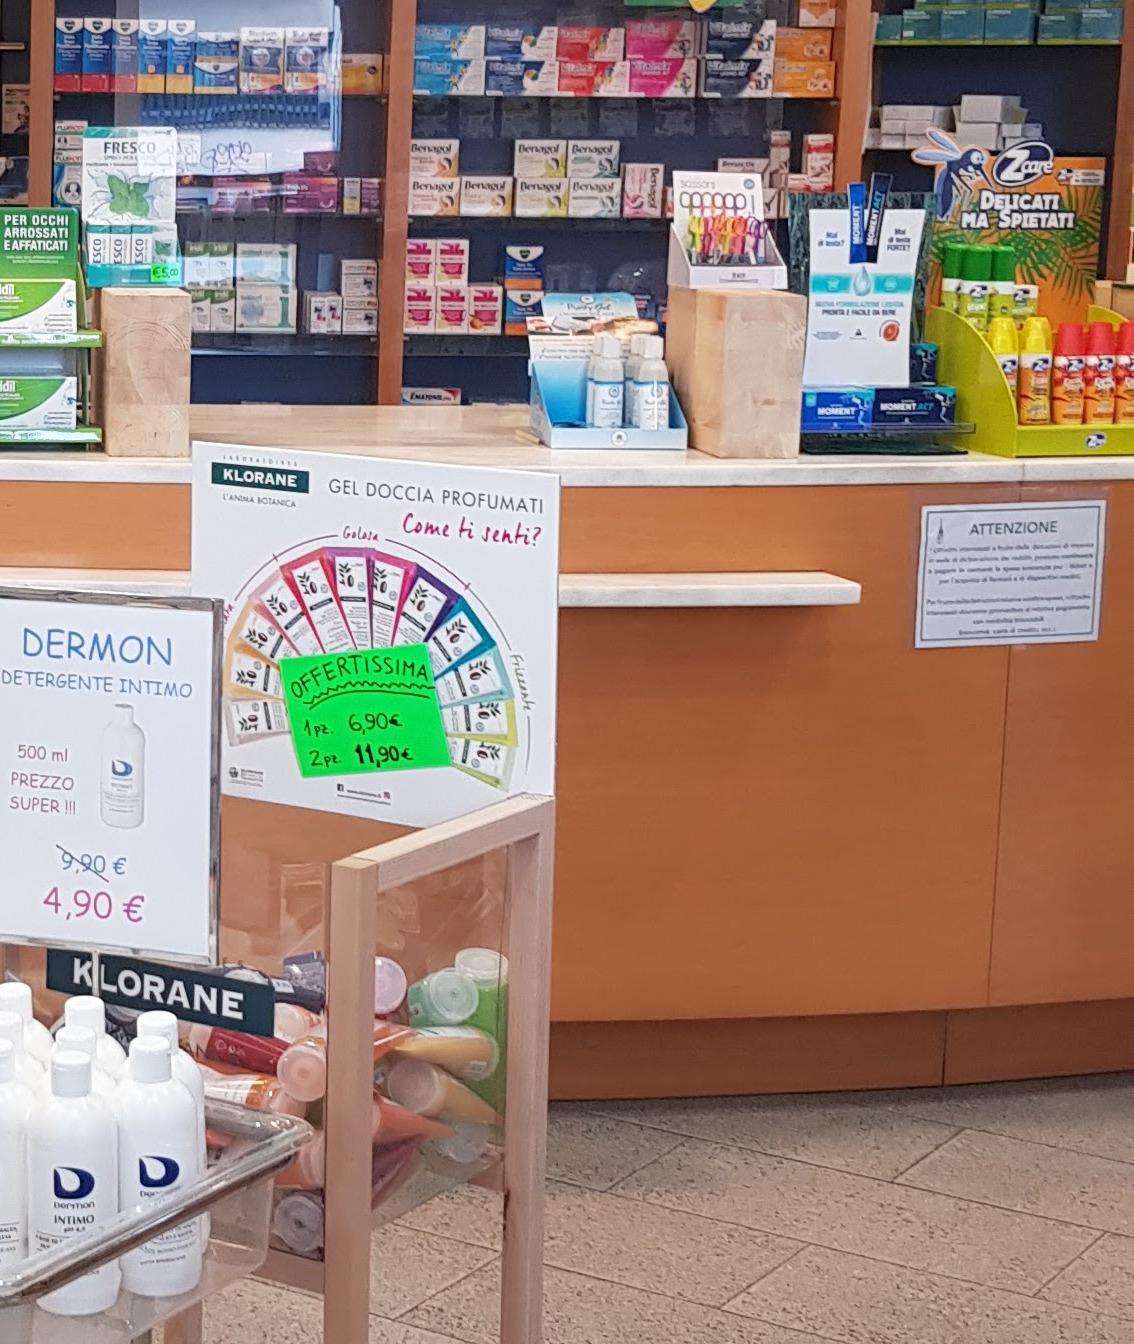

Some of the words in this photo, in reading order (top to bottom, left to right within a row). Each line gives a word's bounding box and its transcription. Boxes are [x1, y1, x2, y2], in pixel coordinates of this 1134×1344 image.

[104, 141, 156, 154] FRESCO
[411, 143, 451, 155] Benagol
[519, 144, 559, 156] Benagol
[572, 144, 613, 156] Benagol
[980, 190, 1059, 211] DELICATI
[4, 215, 27, 226] PER
[32, 215, 68, 226] OCCHI
[852, 205, 862, 245] MOMENT
[961, 212, 988, 229] MA
[998, 210, 1075, 229] SPIETATI
[4, 228, 68, 238] ARROSSATI
[4, 240, 10, 250] E
[12, 240, 68, 251] AFFATICATI
[817, 407, 856, 416] MOMENT
[223, 468, 298, 488] KLORANE
[257, 496, 297, 508] BOTANICA
[329, 479, 359, 496] GEL
[366, 482, 434, 504] DOCCIA
[442, 490, 544, 515] PROFUMATI
[402, 512, 450, 538] Come
[459, 516, 474, 540] ti
[483, 522, 542, 547] senti?
[969, 521, 1058, 535] ATTENZIONE
[23, 627, 172, 666] DERMON
[1, 669, 113, 693] DETERGENTE
[119, 678, 193, 698] INTIMO
[291, 655, 429, 698] OFFERTISSIMA
[17, 744, 47, 761] 500
[52, 748, 68, 762] ml
[309, 750, 323, 766] 2
[355, 743, 414, 767] 11,90€
[11, 772, 74, 791] PREZZO
[10, 796, 60, 813] SUPER
[65, 800, 77, 816] !!!
[61, 851, 106, 875] 9,90
[113, 858, 127, 875] €
[43, 887, 113, 922] 4,90
[123, 895, 145, 923] €
[73, 957, 244, 1020] KLORANE
[54, 1214, 95, 1225] INTIMO
